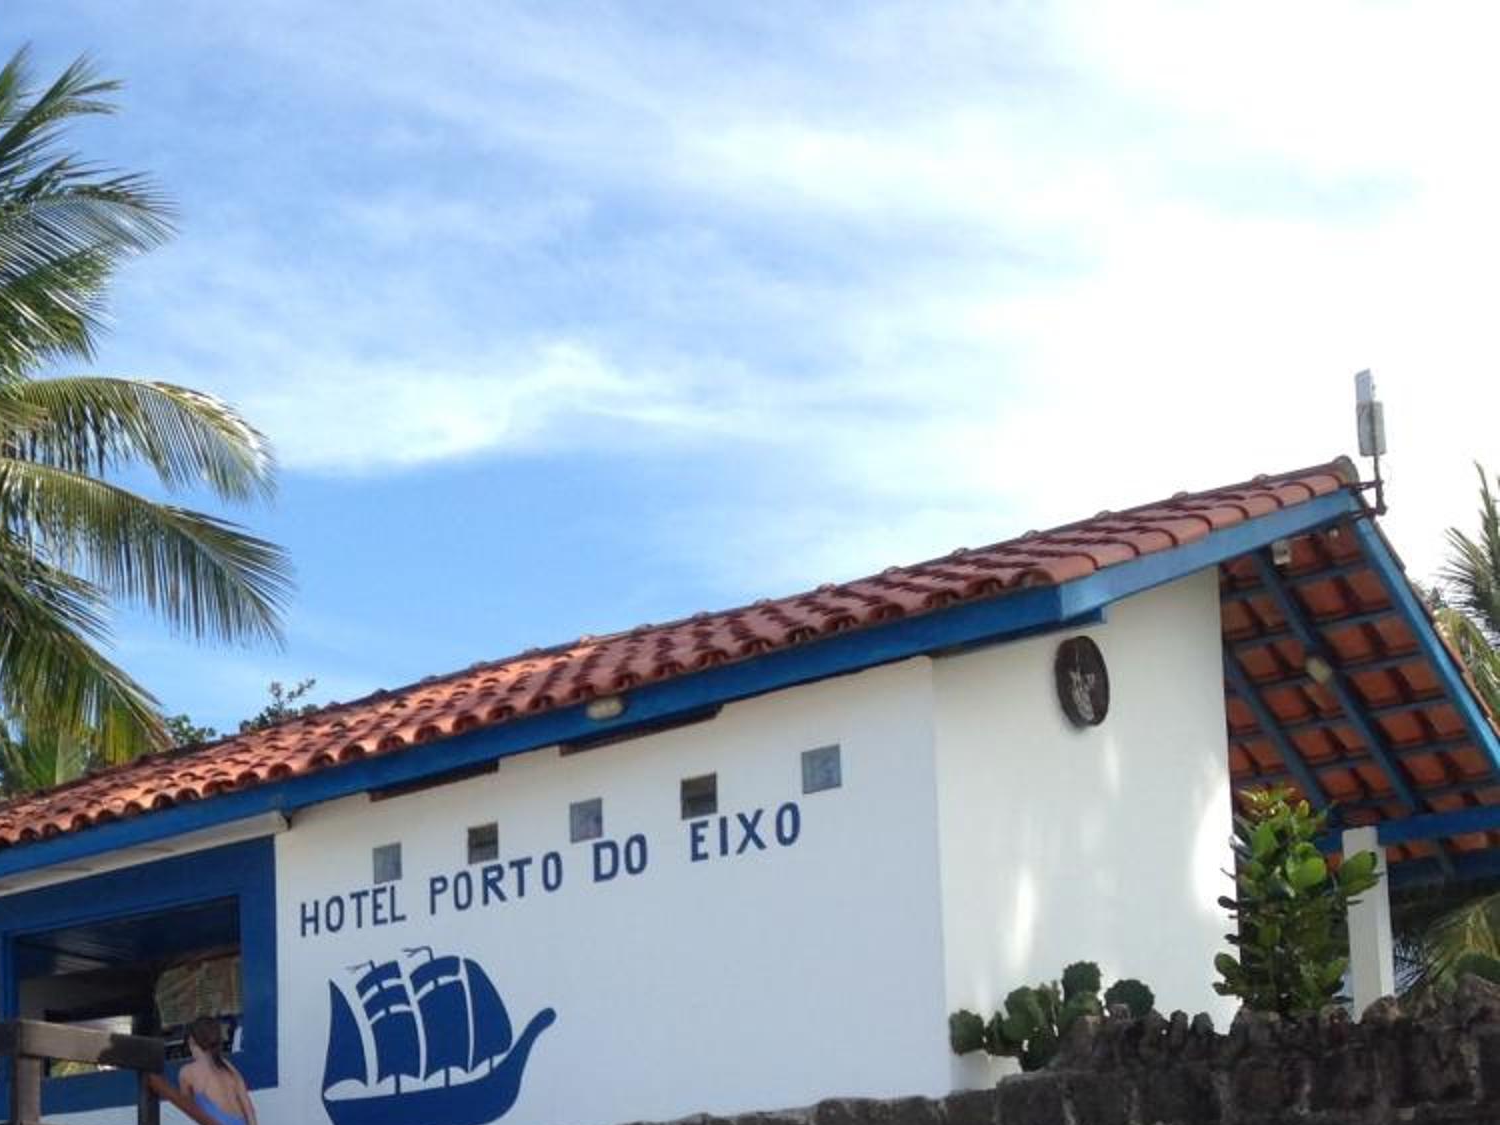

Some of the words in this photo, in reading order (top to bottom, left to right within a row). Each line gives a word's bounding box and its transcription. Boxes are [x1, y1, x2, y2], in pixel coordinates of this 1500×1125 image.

[300, 885, 407, 937] HOTEL
[429, 851, 563, 916] PORTO
[593, 832, 649, 884] DO
[689, 801, 801, 863] EIXO
